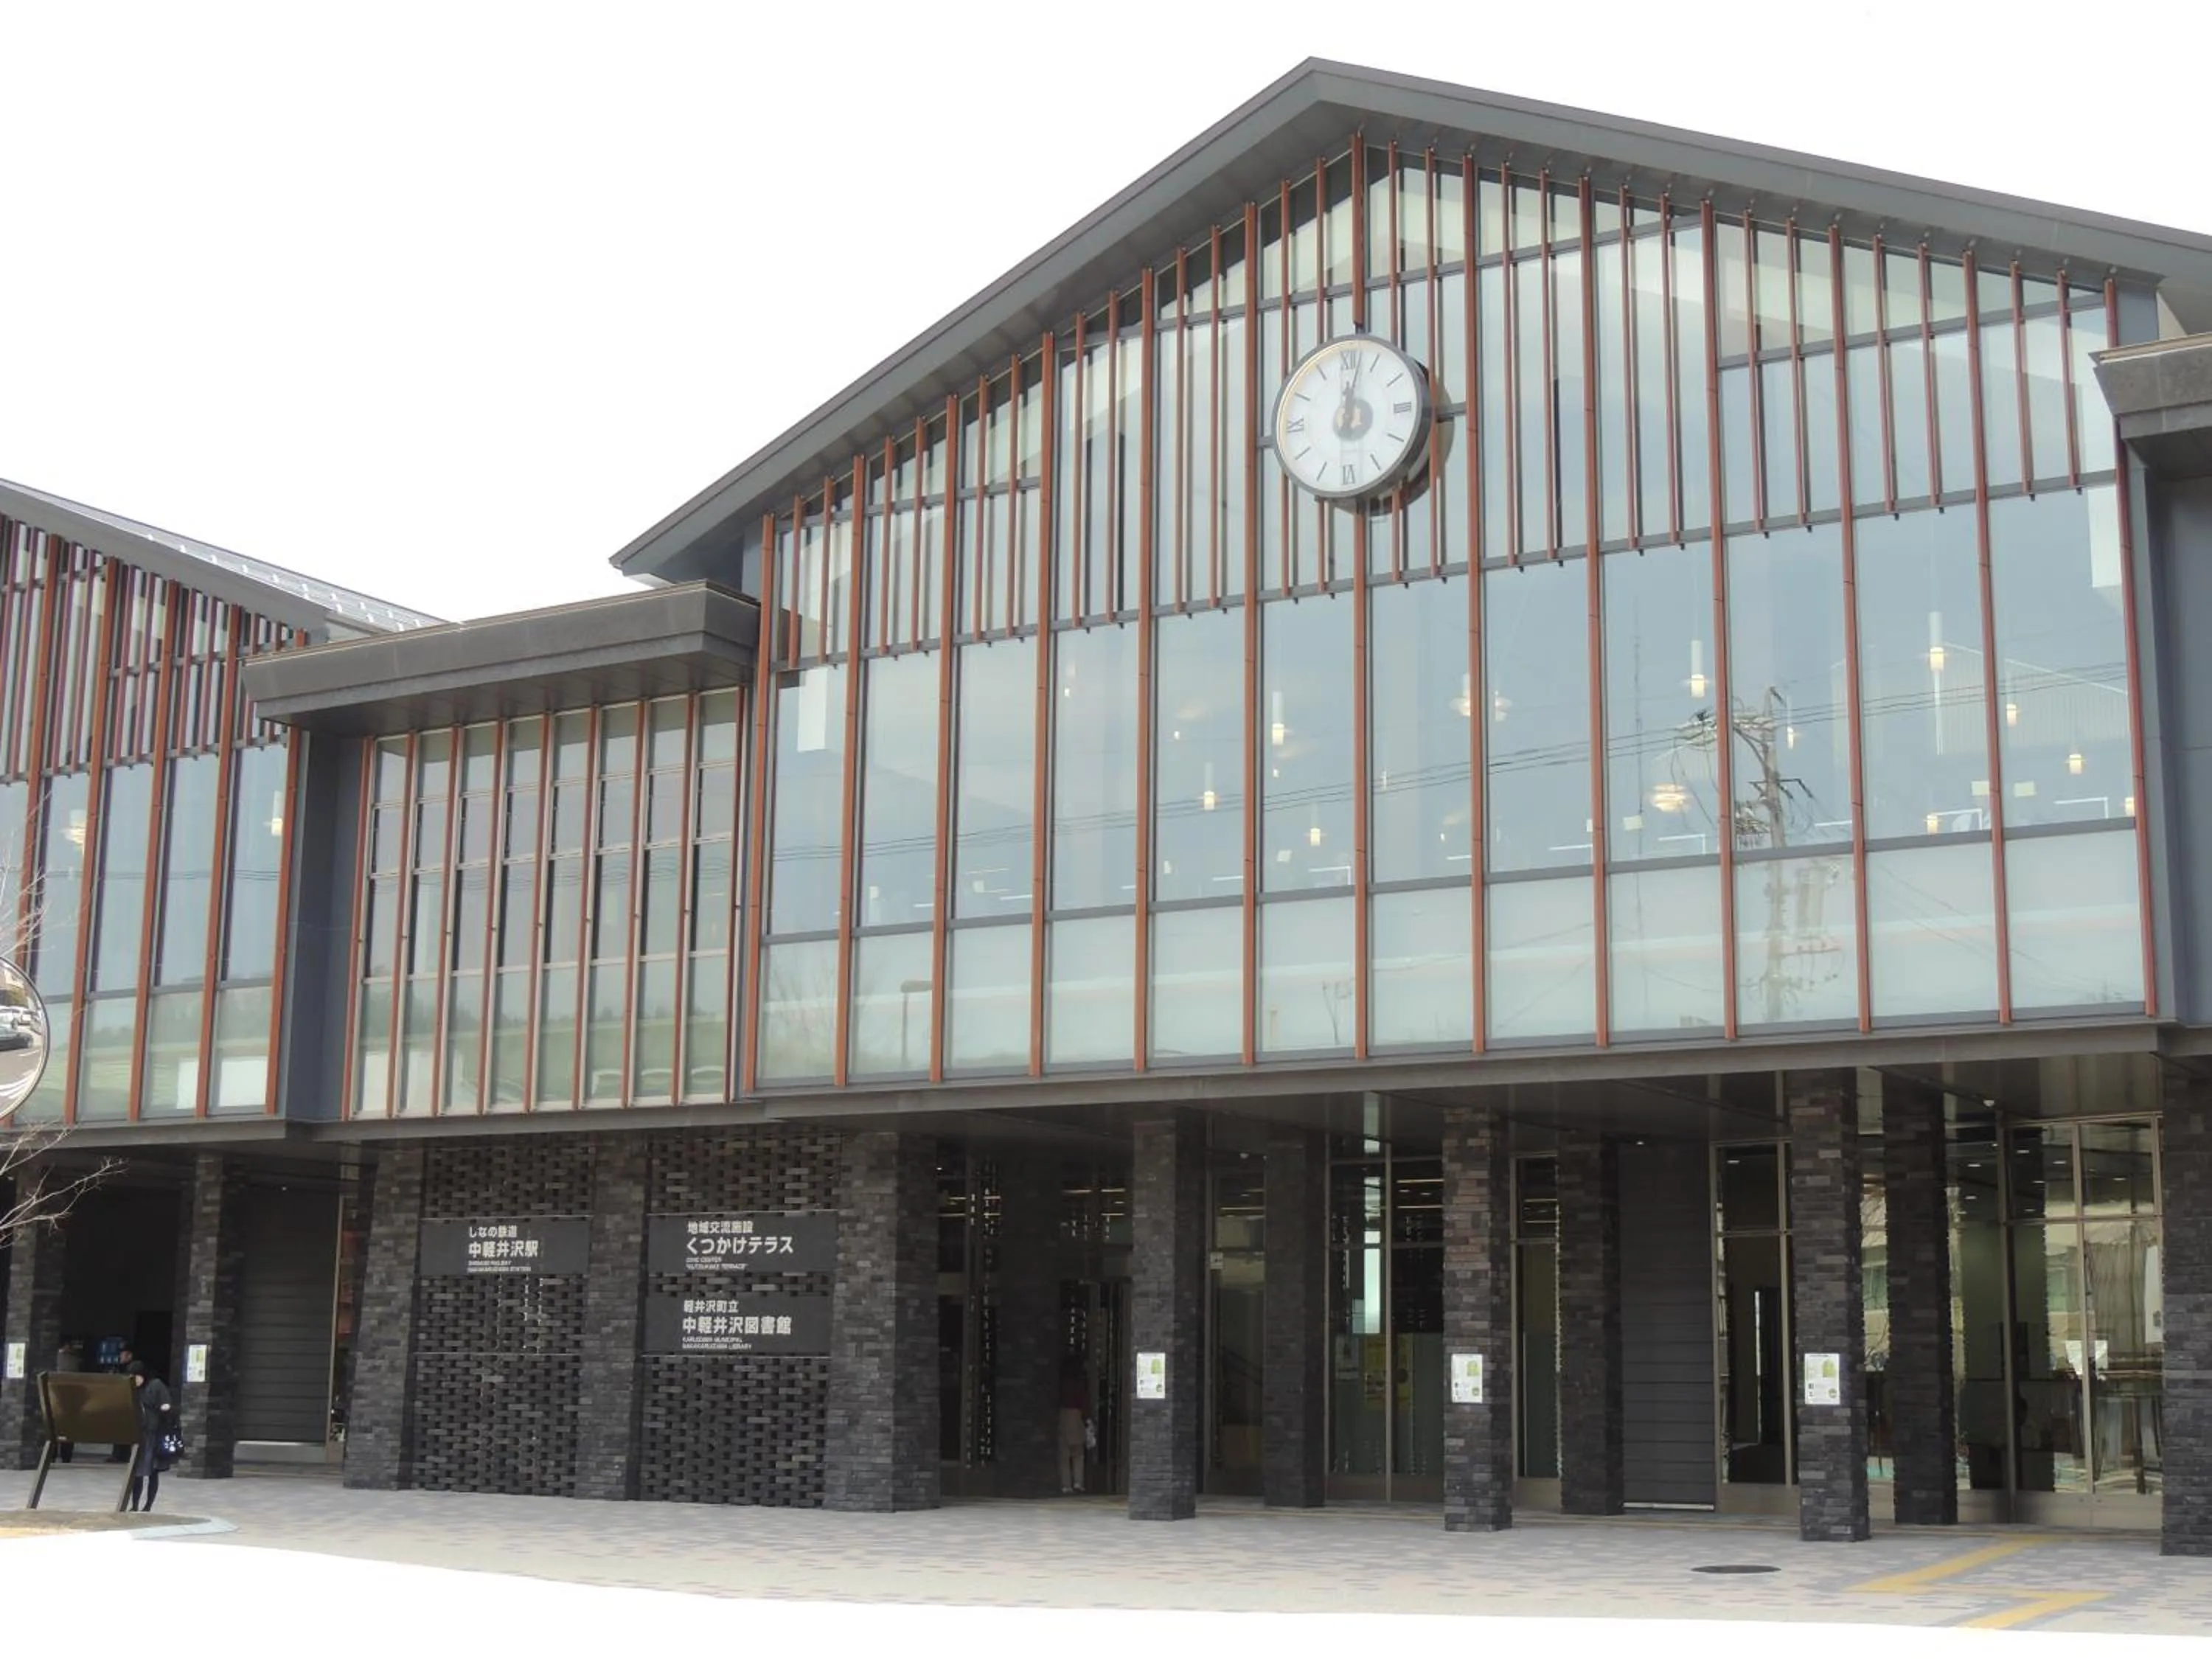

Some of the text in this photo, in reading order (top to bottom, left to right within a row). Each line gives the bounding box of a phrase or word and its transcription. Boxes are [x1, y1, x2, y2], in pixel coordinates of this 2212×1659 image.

[468, 1225, 517, 1238] しなの鉄道
[687, 1221, 754, 1234] 地域交流施設
[468, 1239, 539, 1258] 中軽井沢駅
[686, 1237, 794, 1254] くつかけテラス
[684, 1300, 740, 1313] 軽井沢町立
[682, 1315, 792, 1335] 中軽井沢図書館
